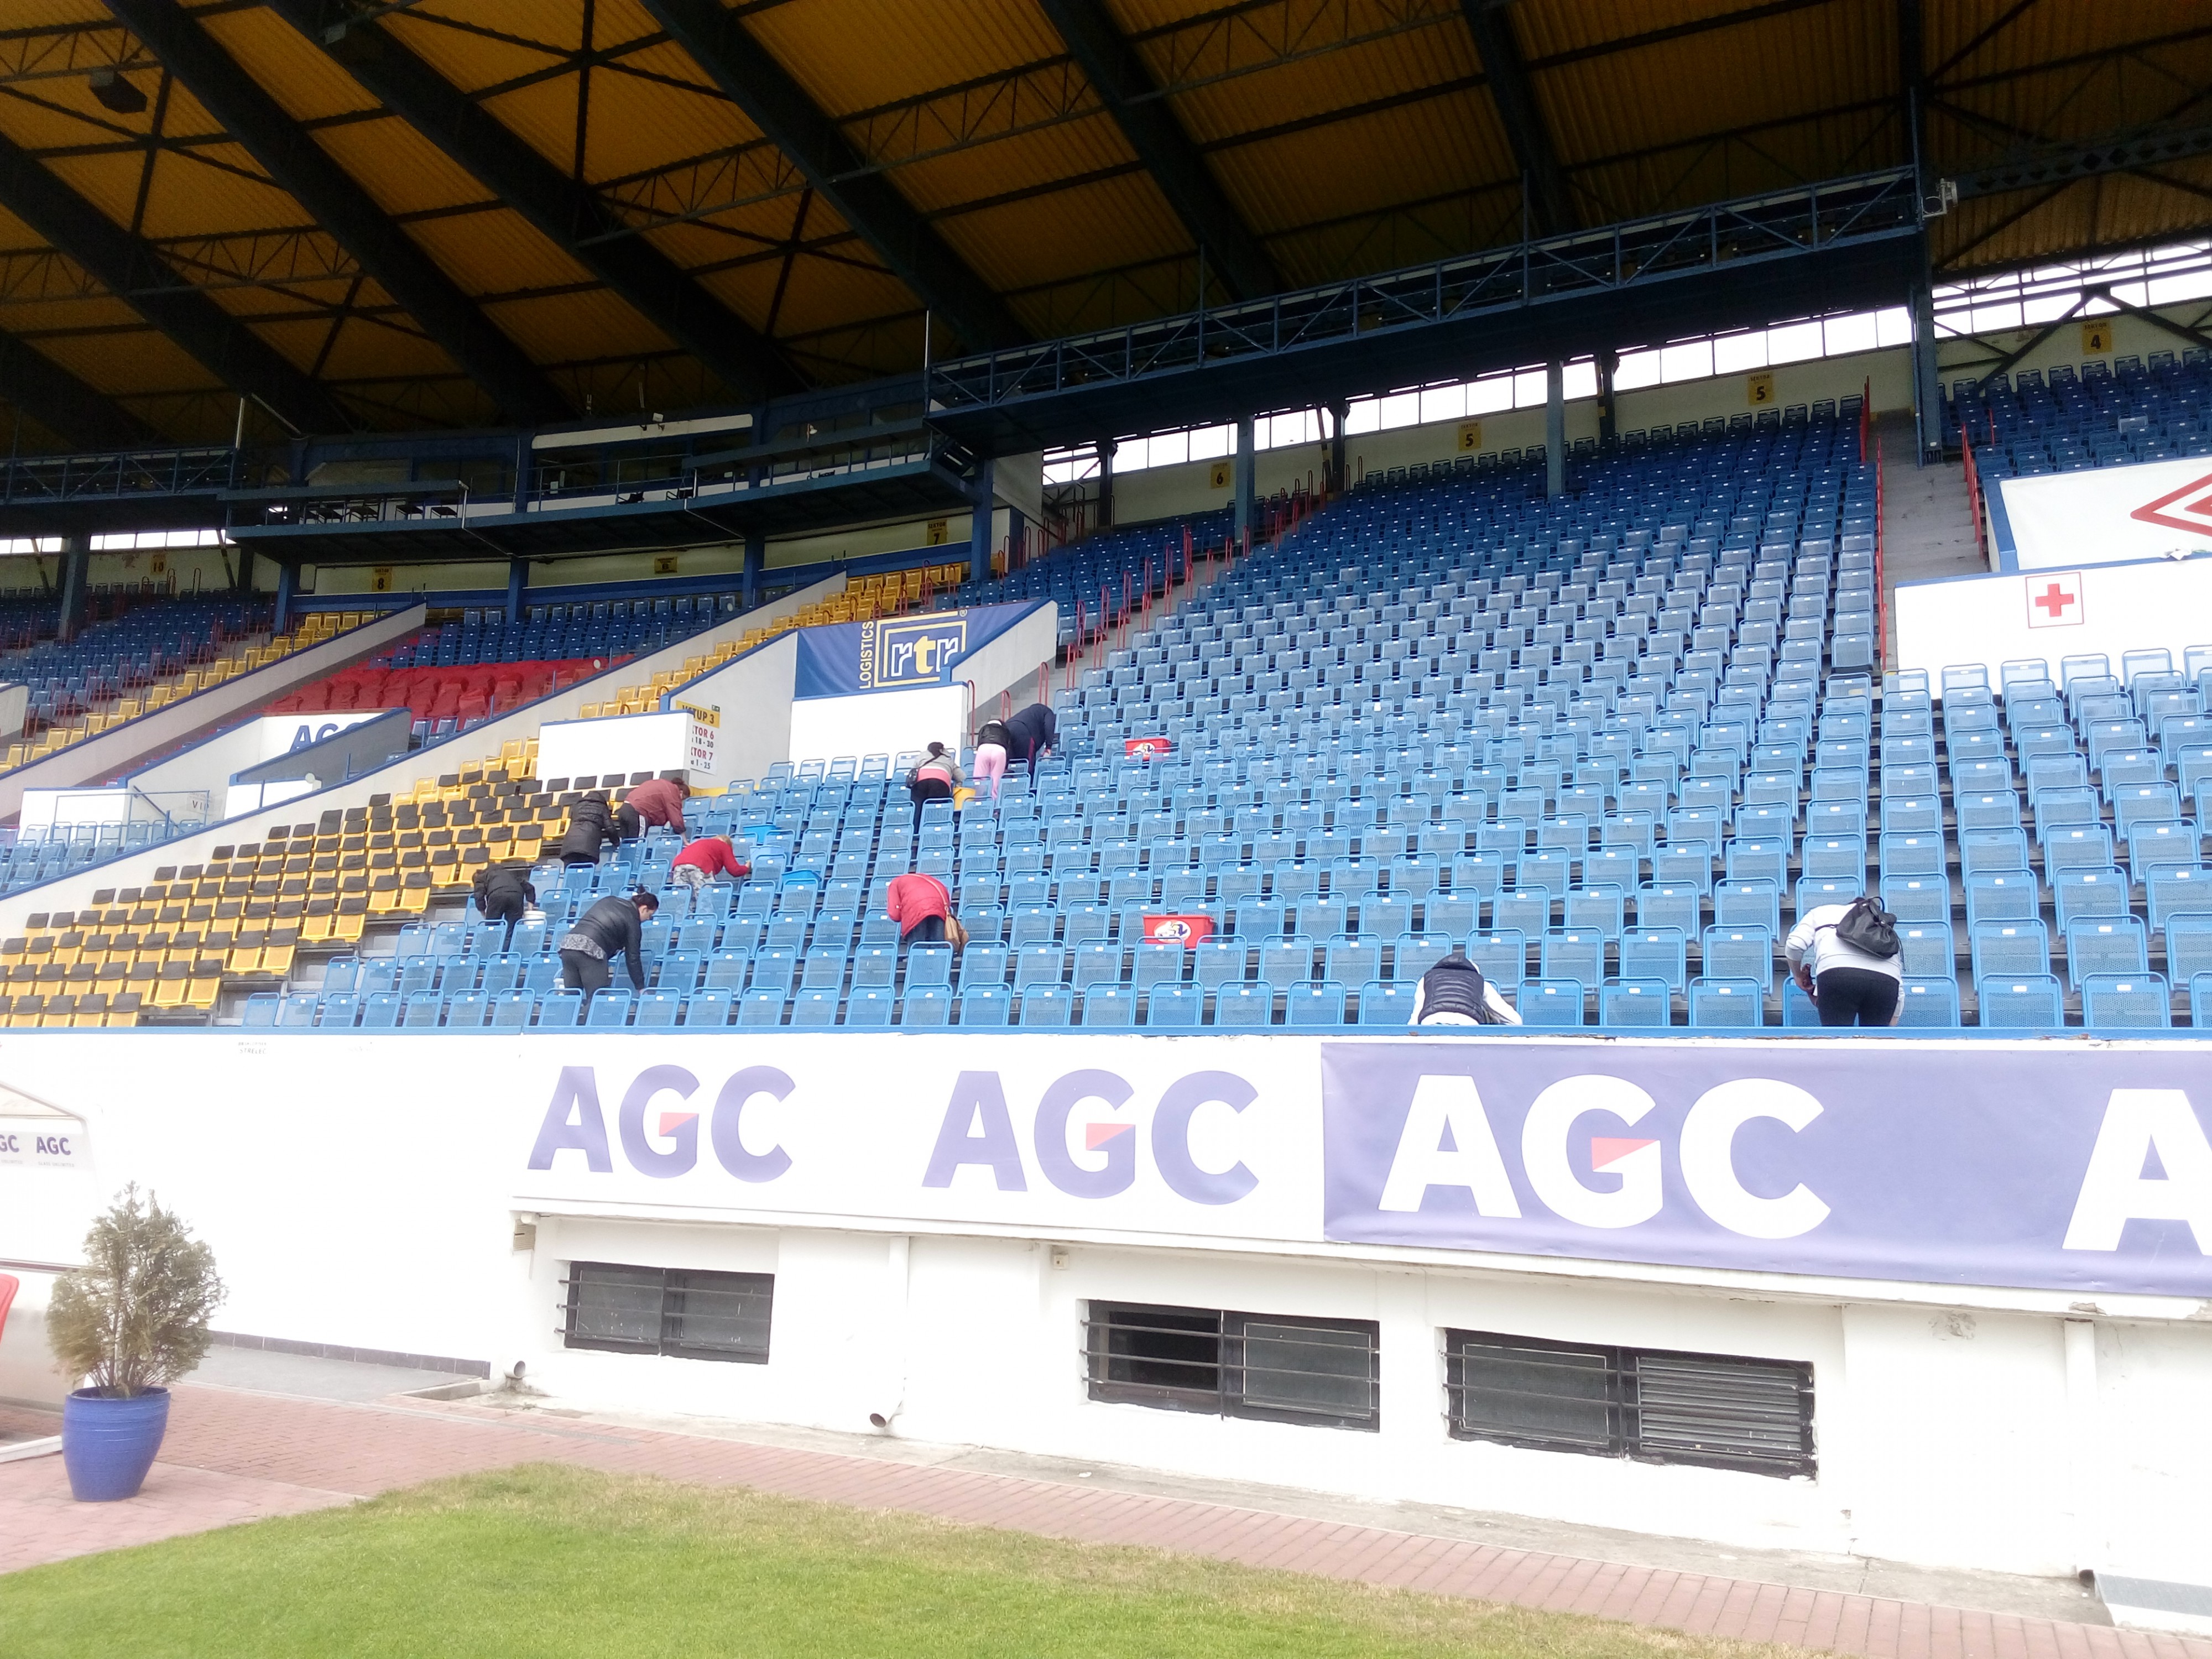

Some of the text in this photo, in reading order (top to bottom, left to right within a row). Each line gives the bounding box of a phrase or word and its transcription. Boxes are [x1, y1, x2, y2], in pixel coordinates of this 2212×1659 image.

[2090, 335, 2101, 349] 4
[1756, 385, 1766, 401] 5
[1465, 433, 1474, 447] 5
[1216, 472, 1223, 485] 6
[933, 533, 940, 545] 7
[377, 577, 385, 590] 8
[859, 620, 874, 689] LOGISTICS
[890, 635, 959, 677] rtr
[709, 713, 714, 724] 3
[709, 731, 714, 740] 6
[709, 752, 713, 761] 7
[527, 1065, 797, 1183] AGC
[921, 1069, 1259, 1205] AGC
[36, 1136, 71, 1156] AGC
[1378, 1074, 1832, 1239] AGC
[2061, 1088, 2212, 1256] A
